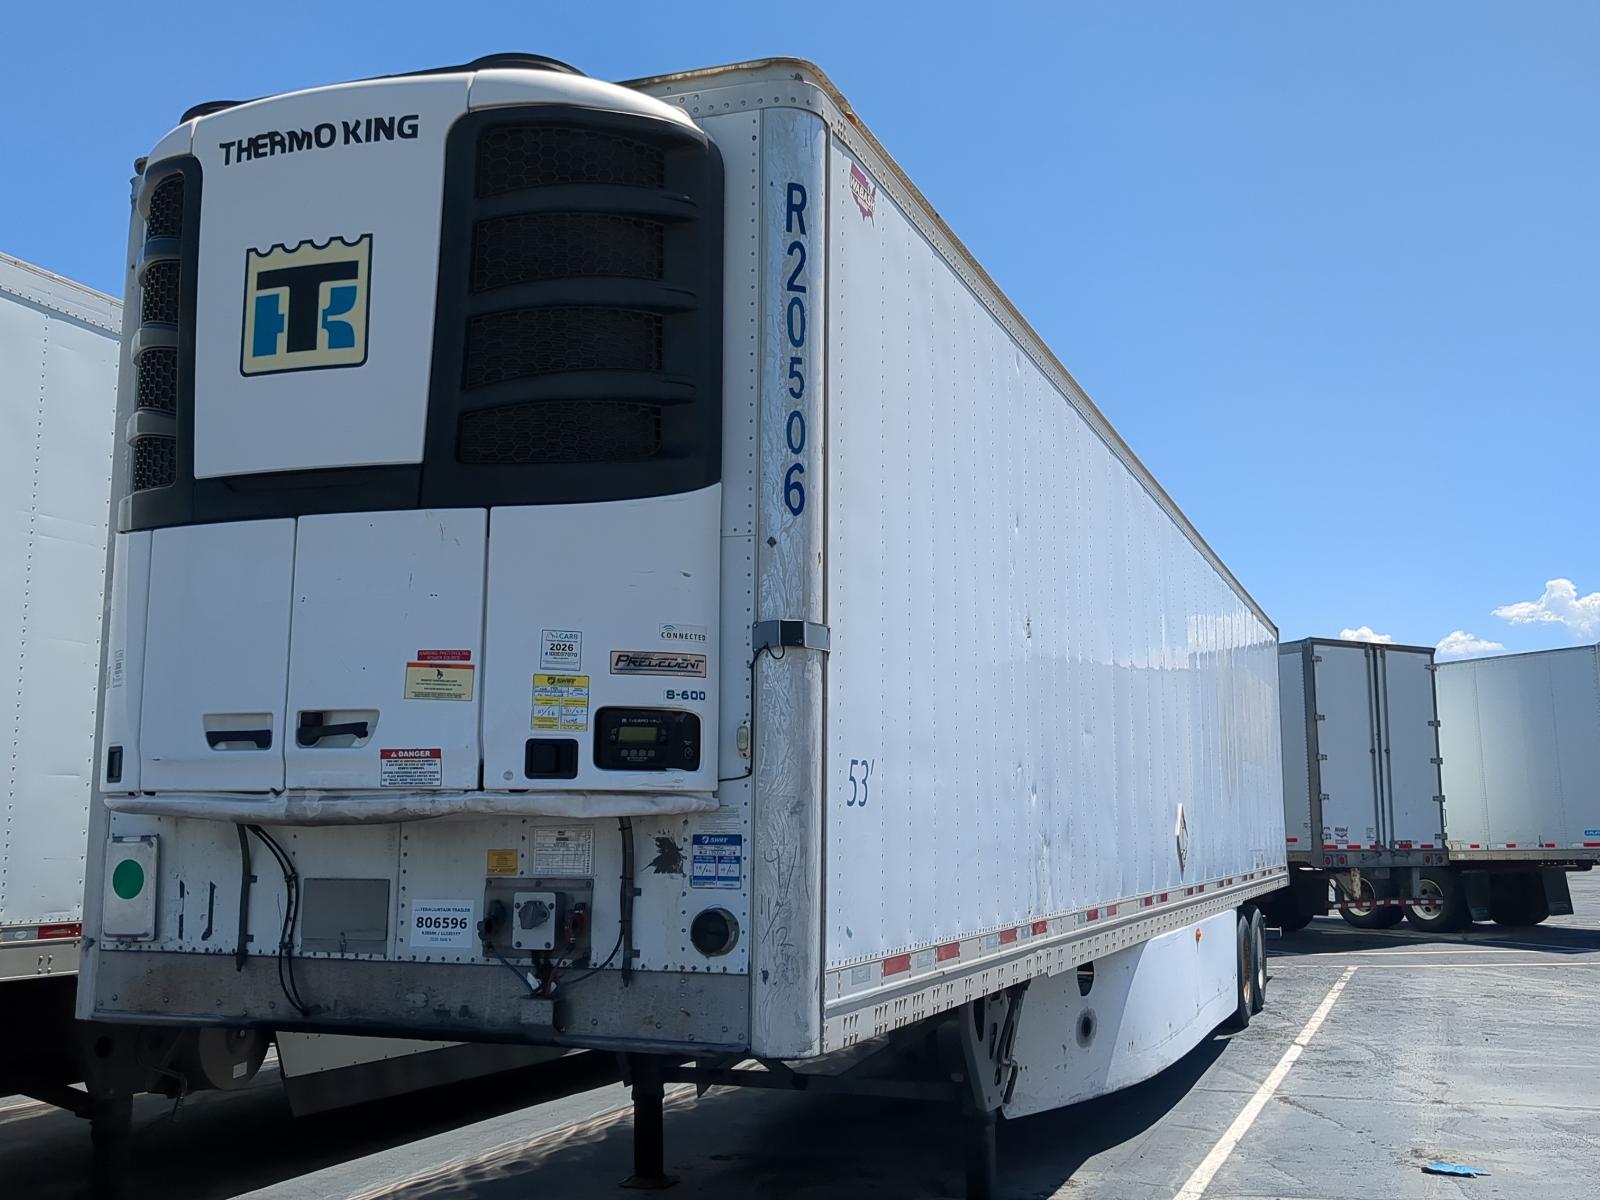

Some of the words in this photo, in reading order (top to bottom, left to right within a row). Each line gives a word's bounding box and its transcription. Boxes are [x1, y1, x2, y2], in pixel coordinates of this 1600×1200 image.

[219, 123, 337, 166] THERMO
[342, 114, 419, 146] KING
[783, 182, 808, 517] R205506
[661, 632, 706, 641] CONNECTED
[550, 643, 574, 652] 2026
[615, 655, 704, 671] PRECEDENT
[399, 750, 431, 758] DANGER
[416, 916, 468, 929] 806596
